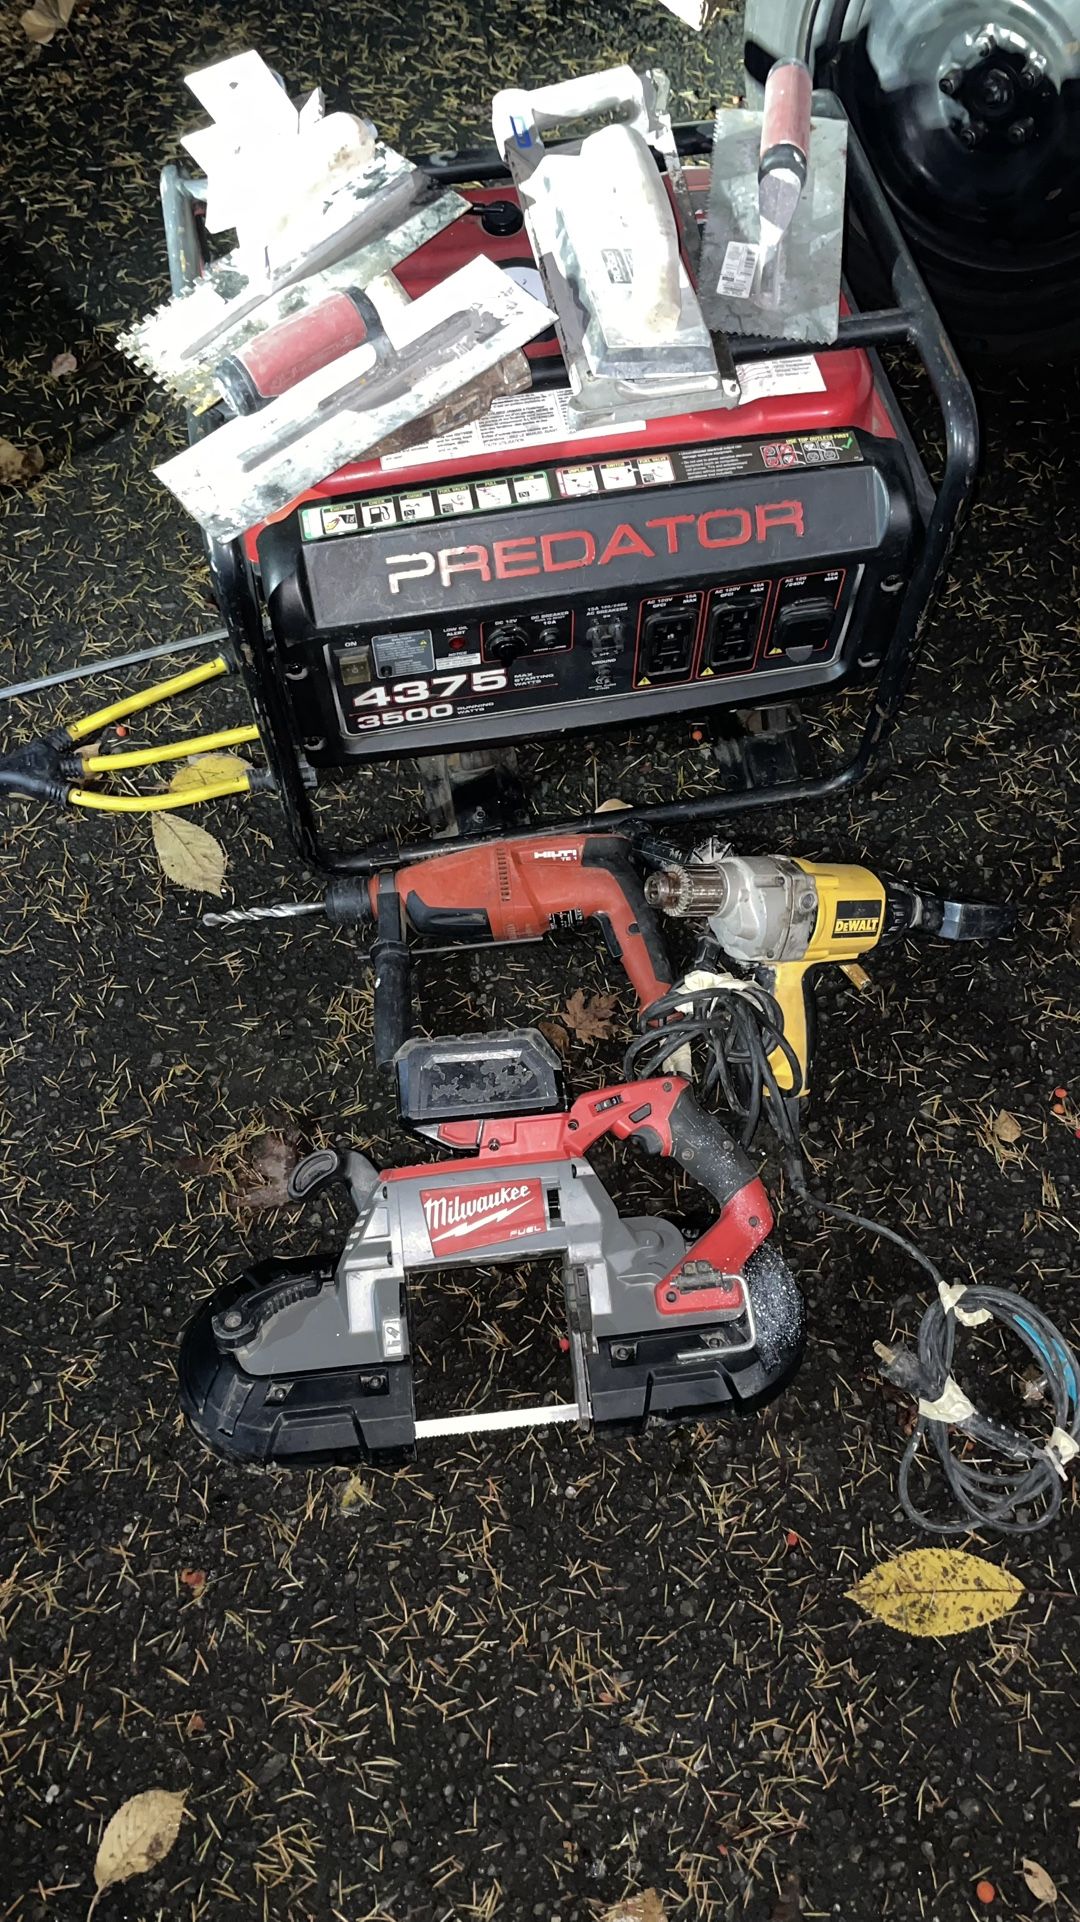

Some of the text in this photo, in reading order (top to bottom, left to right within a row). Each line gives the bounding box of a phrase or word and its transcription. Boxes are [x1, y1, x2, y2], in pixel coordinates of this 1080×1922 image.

[385, 500, 804, 594] PREDATOR
[541, 610, 569, 618] BREAKER
[514, 673, 554, 682] STARTING
[353, 668, 508, 707] 4375
[514, 679, 541, 687] WATTS
[456, 702, 494, 711] RUNNING
[456, 707, 485, 715] WATTS
[357, 704, 454, 729] 3500
[533, 849, 577, 859] HILTI
[424, 1185, 531, 1232] Milwaukee
[510, 1226, 542, 1238] FUEL
